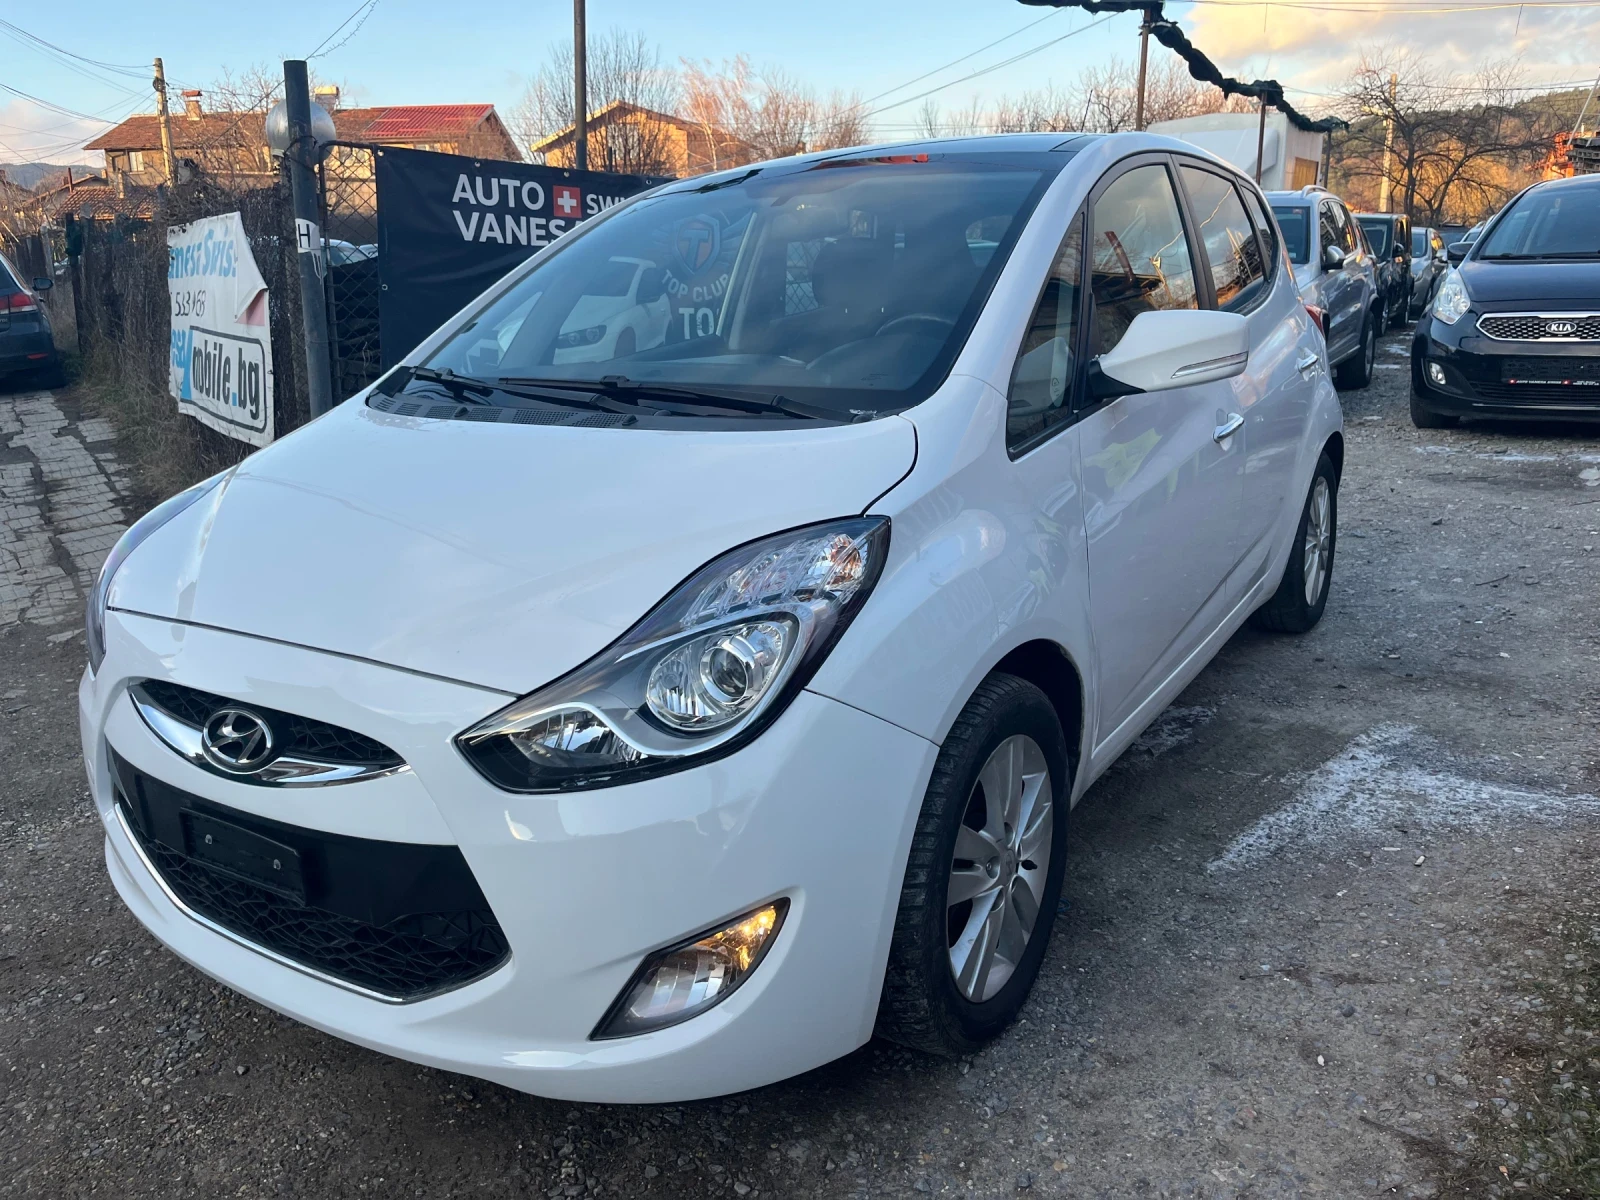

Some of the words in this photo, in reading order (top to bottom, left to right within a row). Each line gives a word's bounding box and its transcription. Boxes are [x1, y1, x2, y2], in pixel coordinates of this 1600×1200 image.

[452, 173, 545, 211] AUTO
[452, 210, 583, 247] VANES
[661, 269, 689, 299] TOP
[1550, 323, 1572, 332] KIA
